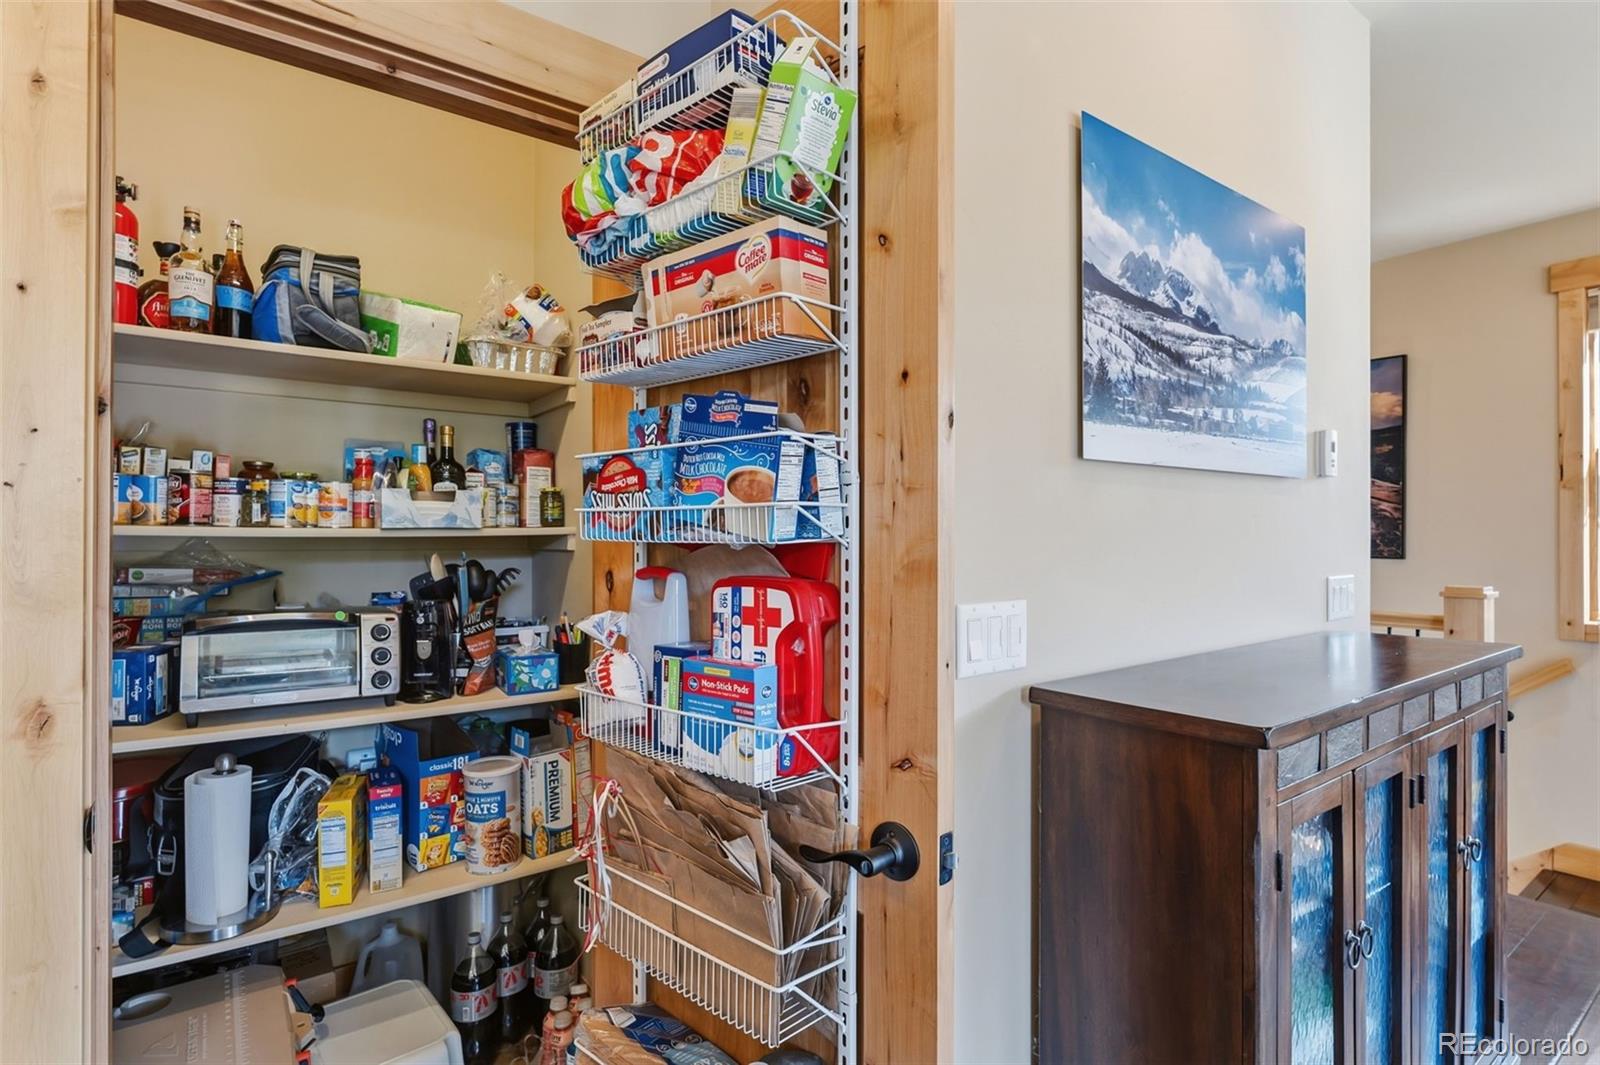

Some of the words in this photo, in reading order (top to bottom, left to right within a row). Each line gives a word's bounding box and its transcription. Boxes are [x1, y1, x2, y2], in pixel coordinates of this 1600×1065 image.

[811, 98, 838, 121] Stevia
[738, 245, 766, 268] Coffee
[745, 253, 767, 273] mate
[701, 679, 732, 691] Non-Stick
[733, 684, 749, 694] Pads
[429, 761, 453, 772] classic
[452, 756, 465, 770] 18
[548, 760, 560, 823] PREMIUM
[375, 803, 396, 811] triscuit
[466, 802, 498, 814] OATS
